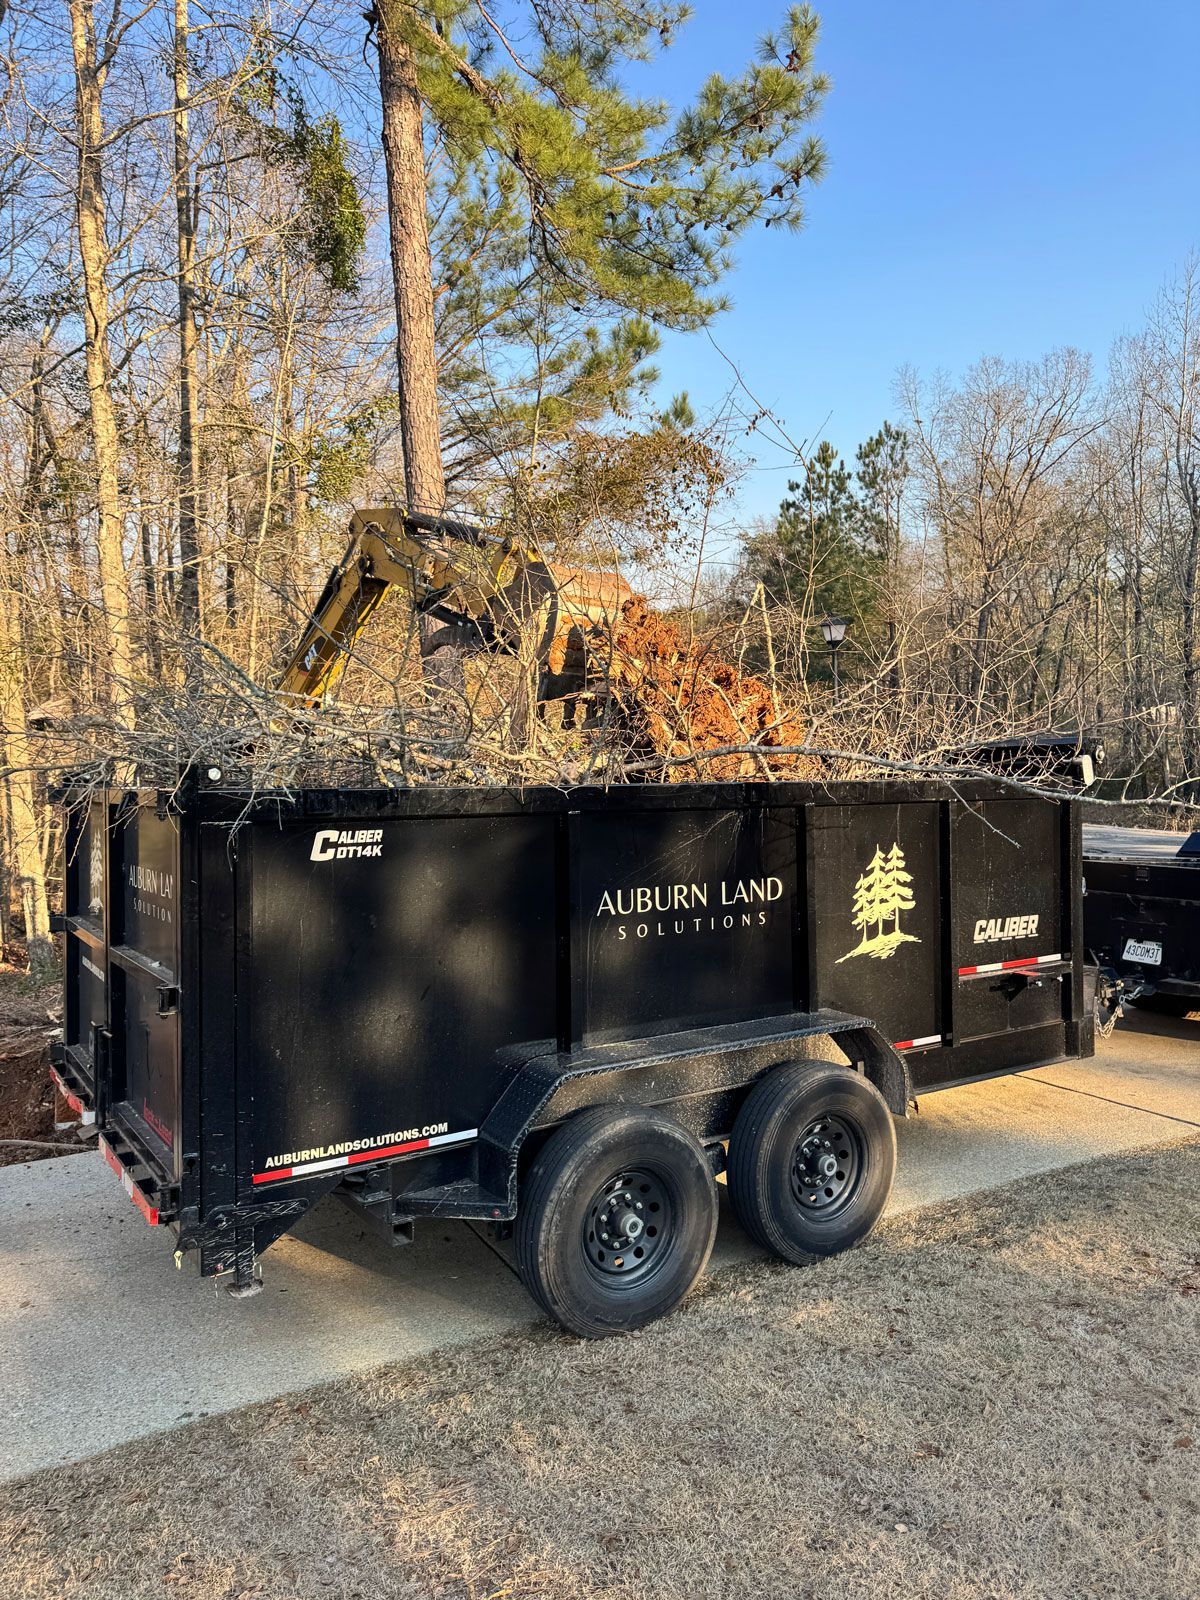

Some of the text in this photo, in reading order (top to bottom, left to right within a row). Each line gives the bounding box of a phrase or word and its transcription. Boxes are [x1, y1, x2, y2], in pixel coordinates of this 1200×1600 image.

[304, 643, 318, 671] CAT
[310, 829, 383, 861] CALIBER
[336, 845, 383, 859] DT14K
[128, 864, 158, 895] AUBURN
[133, 897, 172, 923] SOLUTION
[597, 877, 783, 917] AUBURN LAND
[618, 911, 766, 940] SOLUTIONS
[973, 914, 1039, 941] CALIBER
[264, 1122, 448, 1168] AUBURNLANDSOLUTIONS.COM
